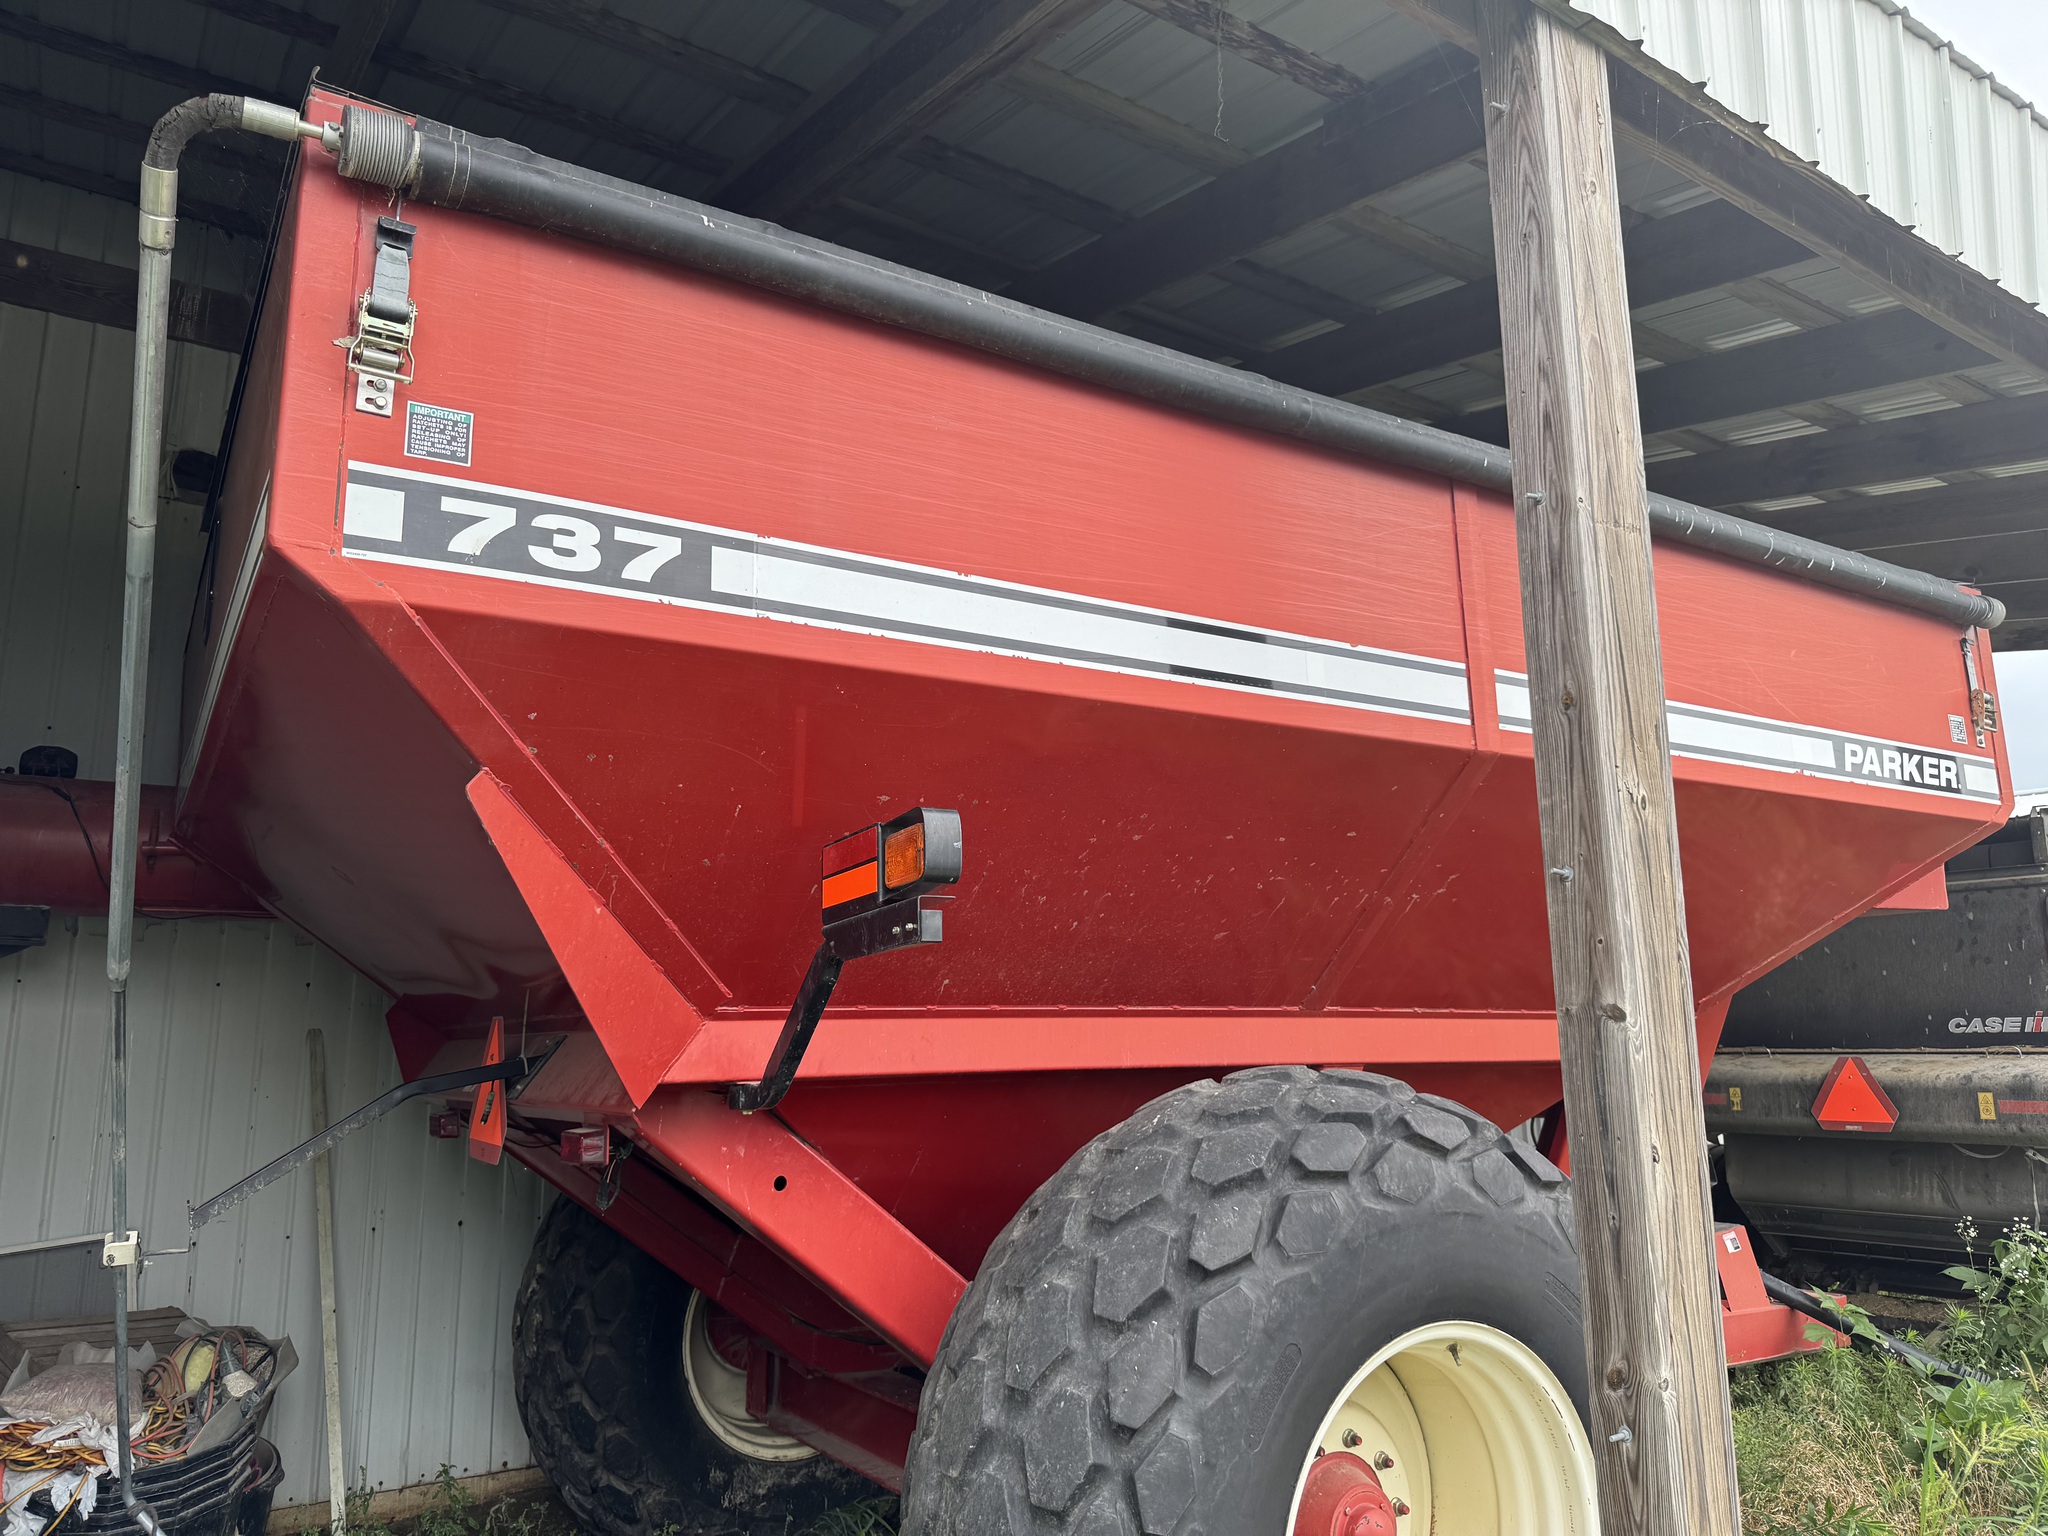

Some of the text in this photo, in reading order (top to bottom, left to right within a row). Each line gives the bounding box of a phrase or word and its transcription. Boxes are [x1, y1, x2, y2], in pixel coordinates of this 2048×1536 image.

[414, 405, 466, 422] IMPORTANT
[412, 414, 453, 425] ADJUSTING
[412, 419, 444, 429] RATCHETS
[412, 424, 440, 432] SET-UP
[411, 434, 447, 444] RATCHETS
[412, 429, 451, 440] RELEASING
[411, 444, 451, 455] TENSIONING
[435, 443, 465, 452] IMPROPER
[440, 496, 682, 583] 737
[1948, 1016, 2023, 1034] CASE
